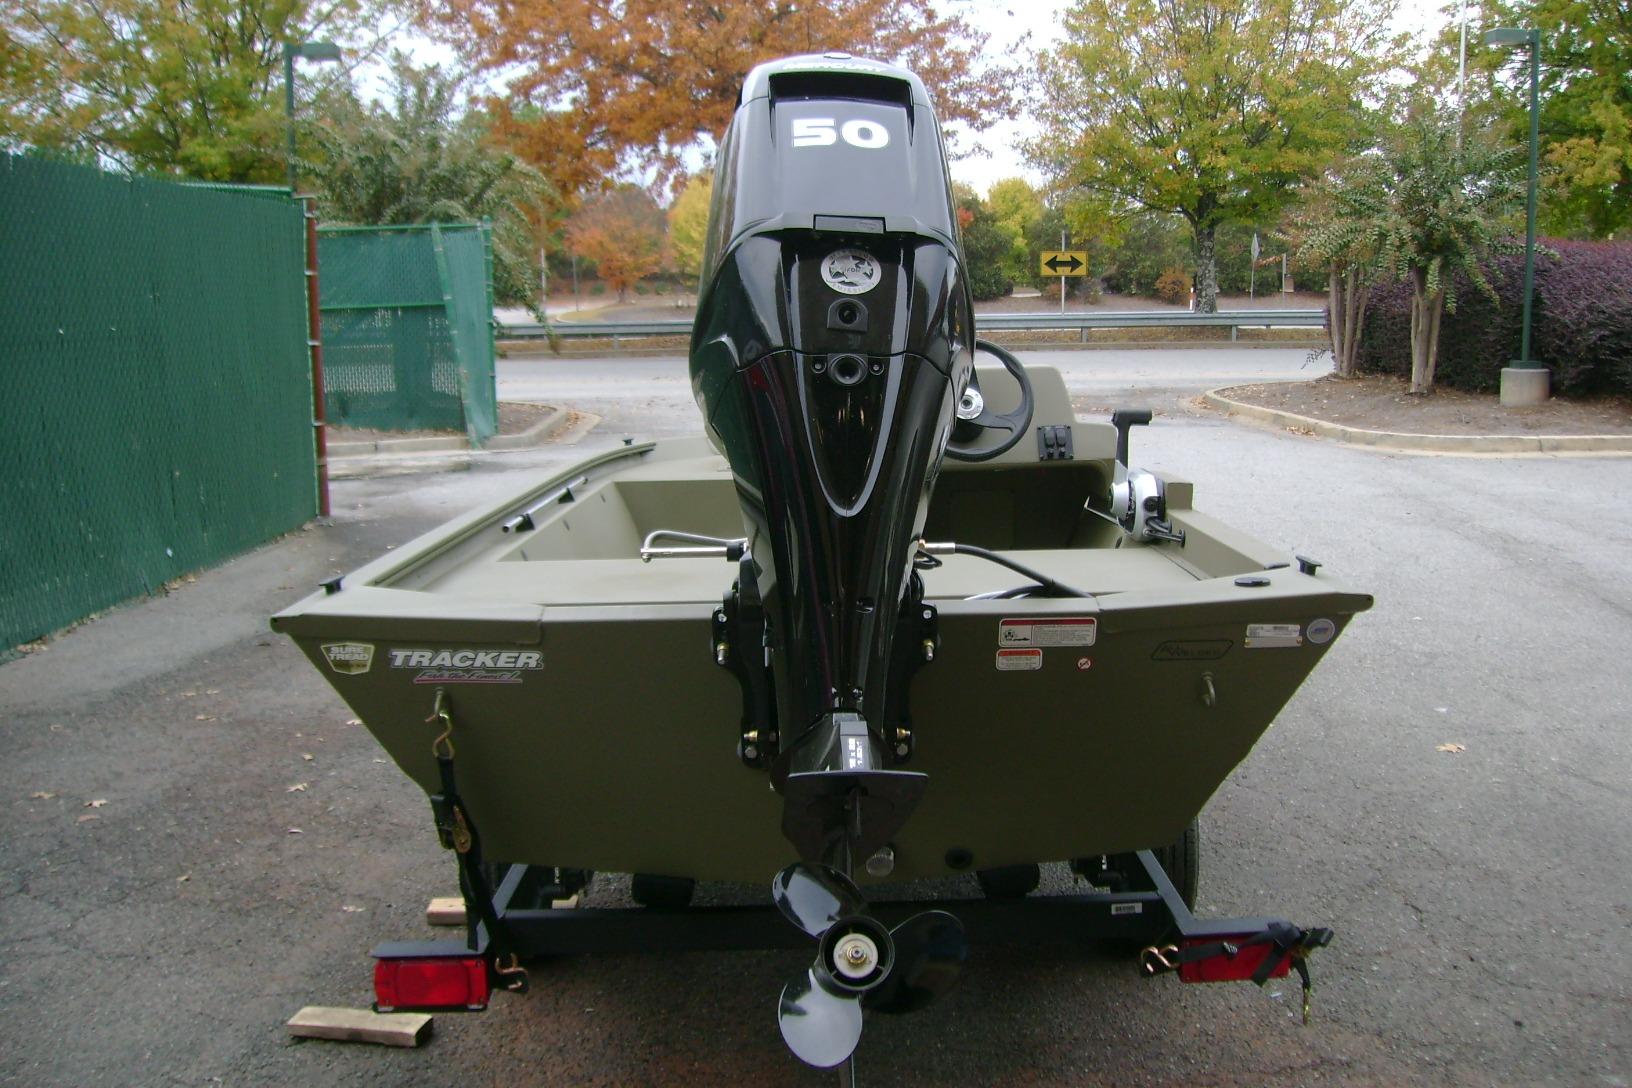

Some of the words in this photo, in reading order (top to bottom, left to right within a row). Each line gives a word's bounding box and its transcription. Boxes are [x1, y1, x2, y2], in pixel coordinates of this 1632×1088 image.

[793, 118, 889, 149] 50
[329, 646, 364, 654] SURE
[328, 653, 369, 661] TREAD
[390, 651, 541, 669] TRACKER
